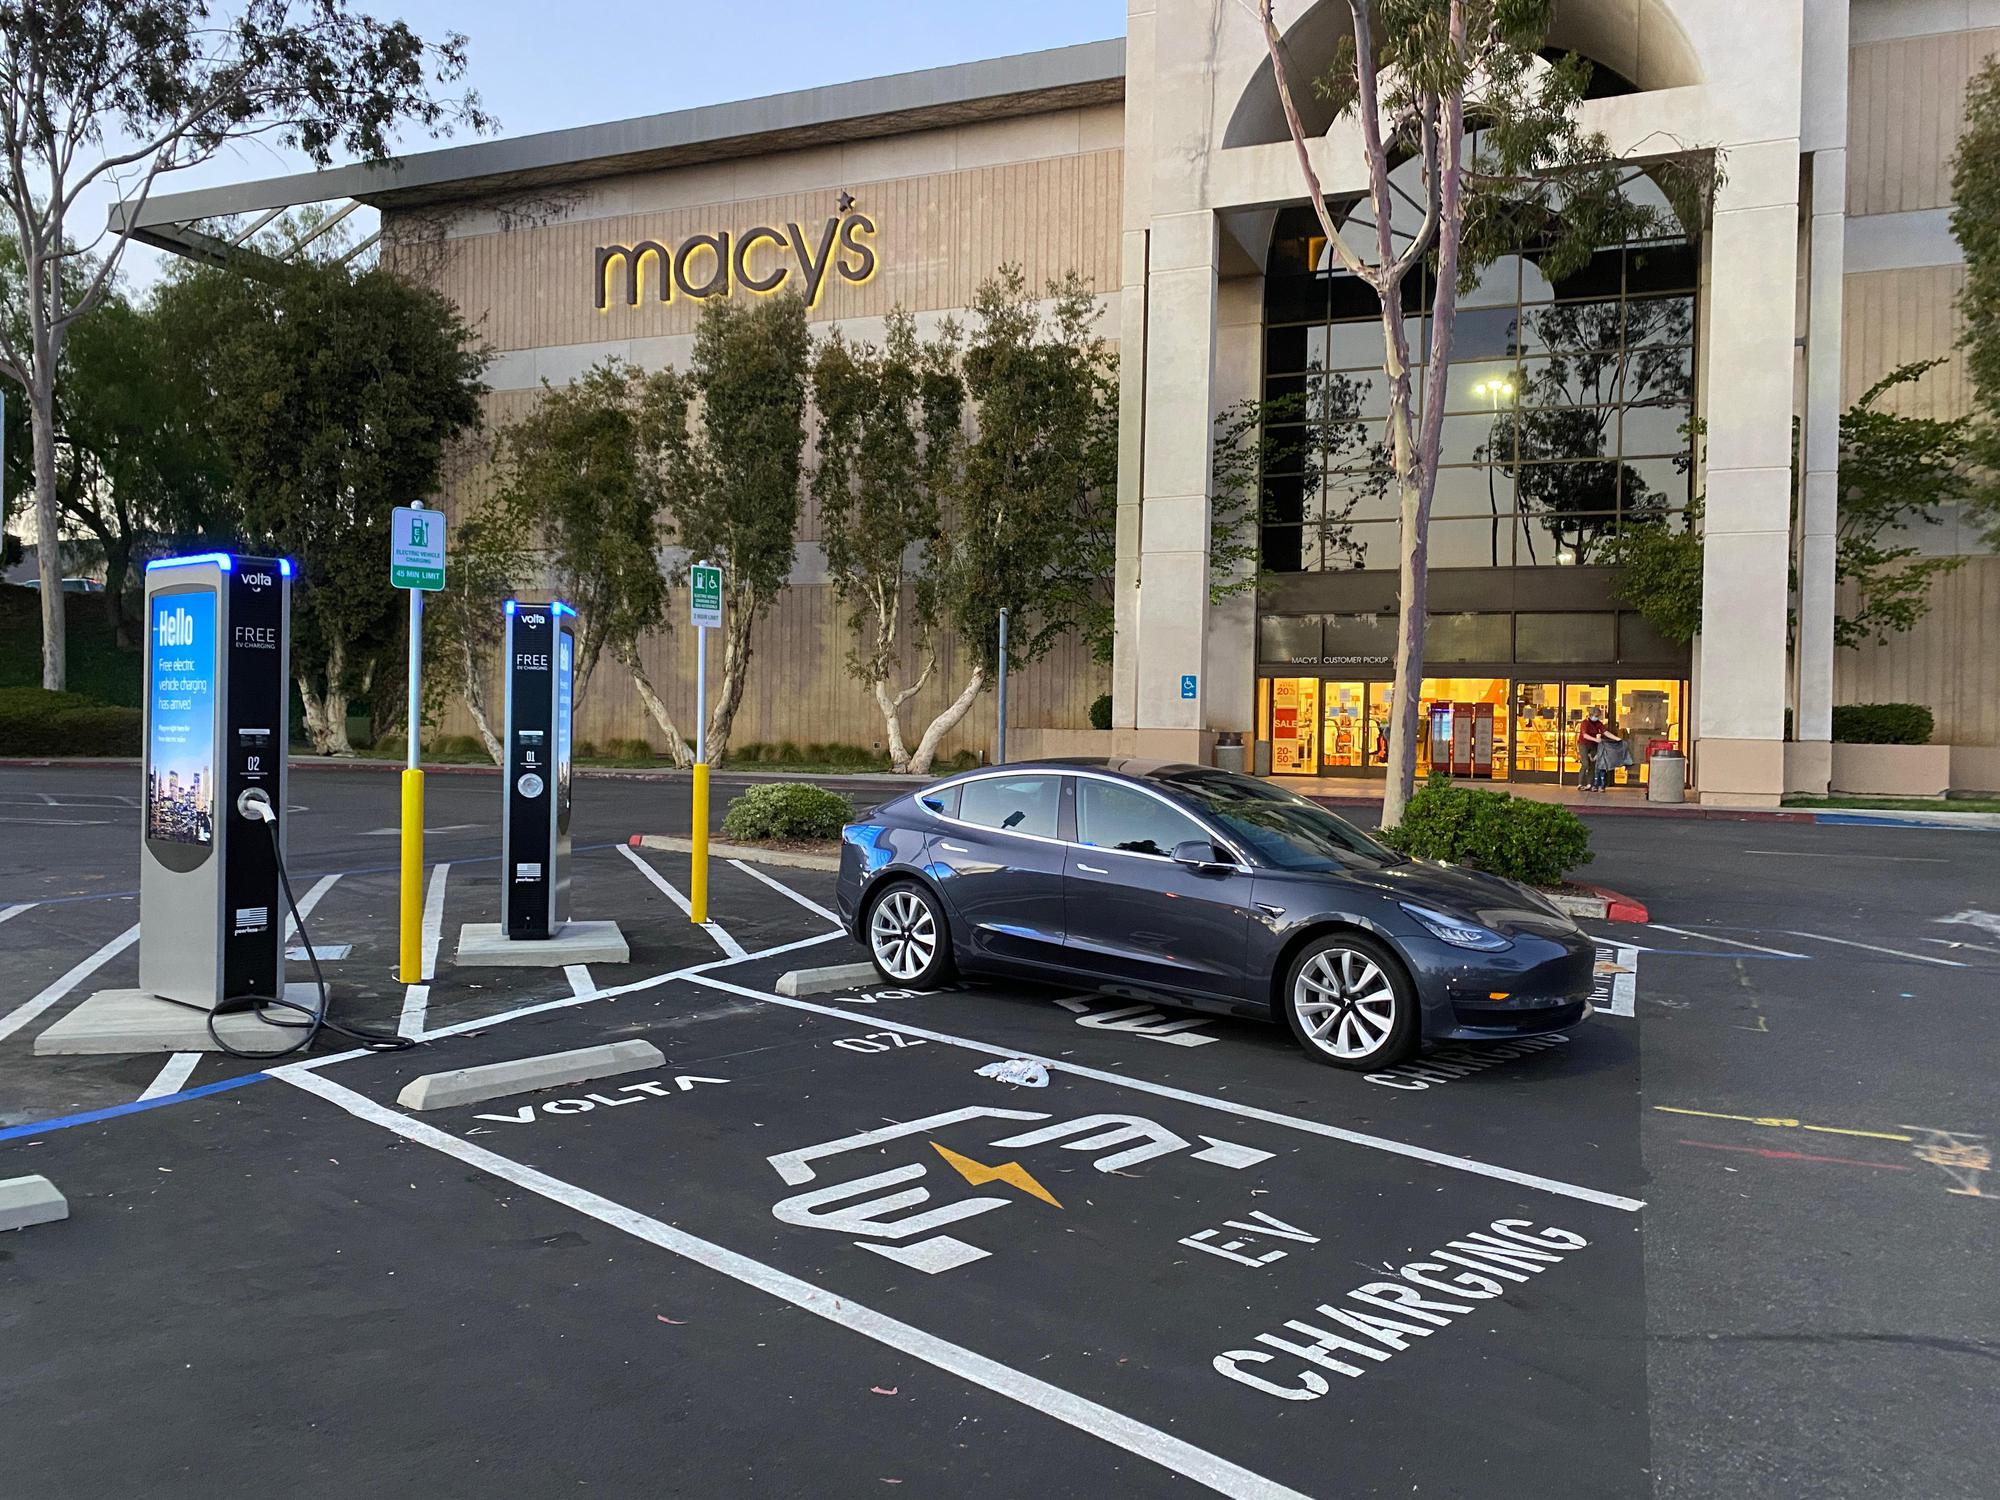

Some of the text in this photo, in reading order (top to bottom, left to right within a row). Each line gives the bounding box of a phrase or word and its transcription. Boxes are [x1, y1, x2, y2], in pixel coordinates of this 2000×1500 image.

[241, 573, 272, 586] volta
[406, 570, 420, 578] MIN
[422, 572, 440, 580] LIMIT
[521, 614, 545, 624] volta
[160, 608, 193, 646] Hello
[235, 627, 276, 642] FREE
[159, 657, 195, 671] Free electric
[516, 654, 548, 666] FREE
[1291, 656, 1389, 664] MACY'S CUSTOMER PICKUP
[180, 677, 207, 694] charging
[1275, 720, 1297, 728] SALE
[526, 750, 535, 762] 01
[247, 756, 260, 771] 02
[832, 1032, 927, 1053] 02
[472, 1074, 731, 1125] VOLTA
[1177, 1210, 1321, 1268] EV
[1212, 1218, 1587, 1401] CHARGING
